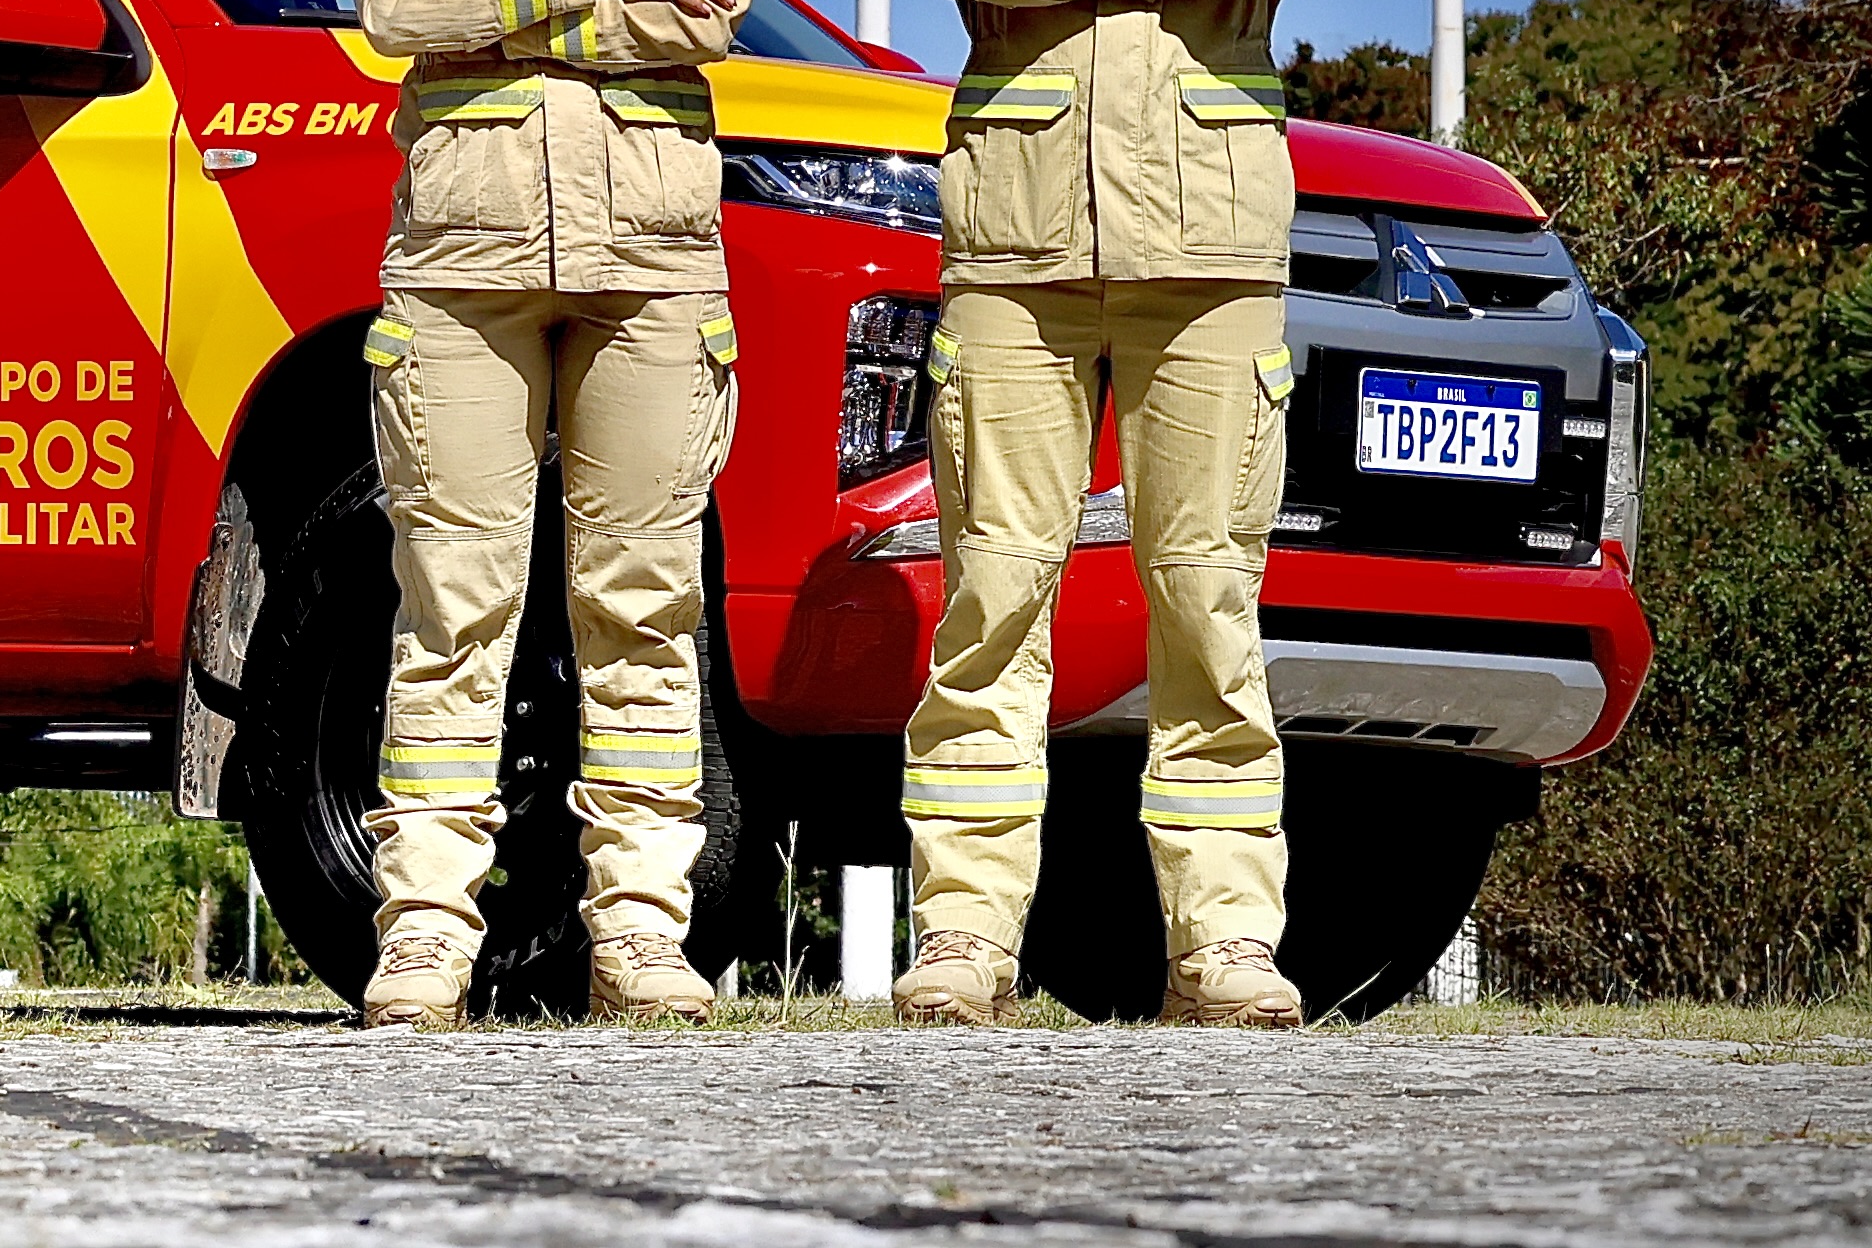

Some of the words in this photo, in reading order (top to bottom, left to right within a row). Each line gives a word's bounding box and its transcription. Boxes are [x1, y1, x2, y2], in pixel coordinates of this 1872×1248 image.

[201, 103, 300, 135] ABS
[304, 103, 379, 135] BM
[77, 361, 134, 401] DE
[1437, 387, 1466, 402] BRASIL
[1378, 404, 1520, 468] TBP2F13
